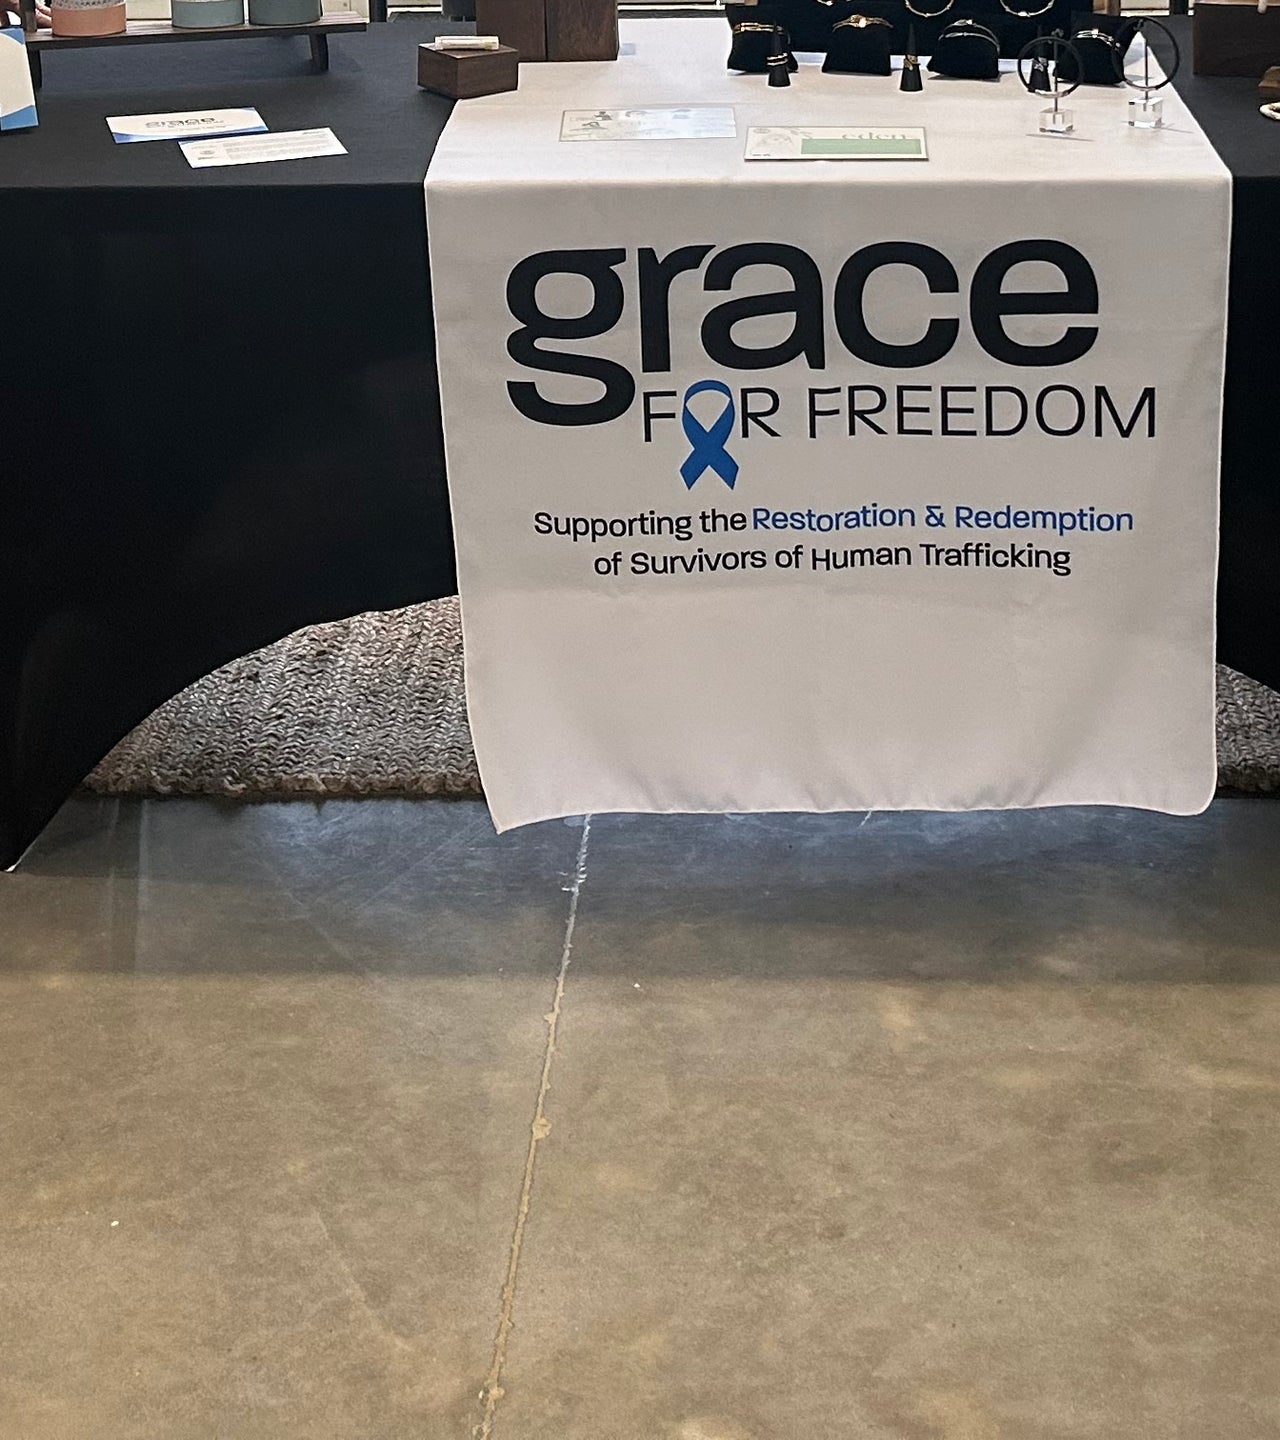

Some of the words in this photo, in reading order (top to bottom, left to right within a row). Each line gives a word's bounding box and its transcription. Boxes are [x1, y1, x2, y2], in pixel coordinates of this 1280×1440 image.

[506, 240, 1100, 427] grace
[642, 380, 782, 456] FOR
[807, 383, 1157, 440] FREEDOM
[533, 510, 693, 543] Supporting
[698, 508, 747, 534] the
[752, 502, 916, 533] Restoration
[924, 504, 947, 529] &
[954, 504, 1134, 536] Redemption
[593, 550, 622, 576] of
[630, 545, 768, 575] Survivors
[774, 543, 804, 570] of
[811, 542, 913, 572] Human
[918, 541, 1072, 577] Trafficking
